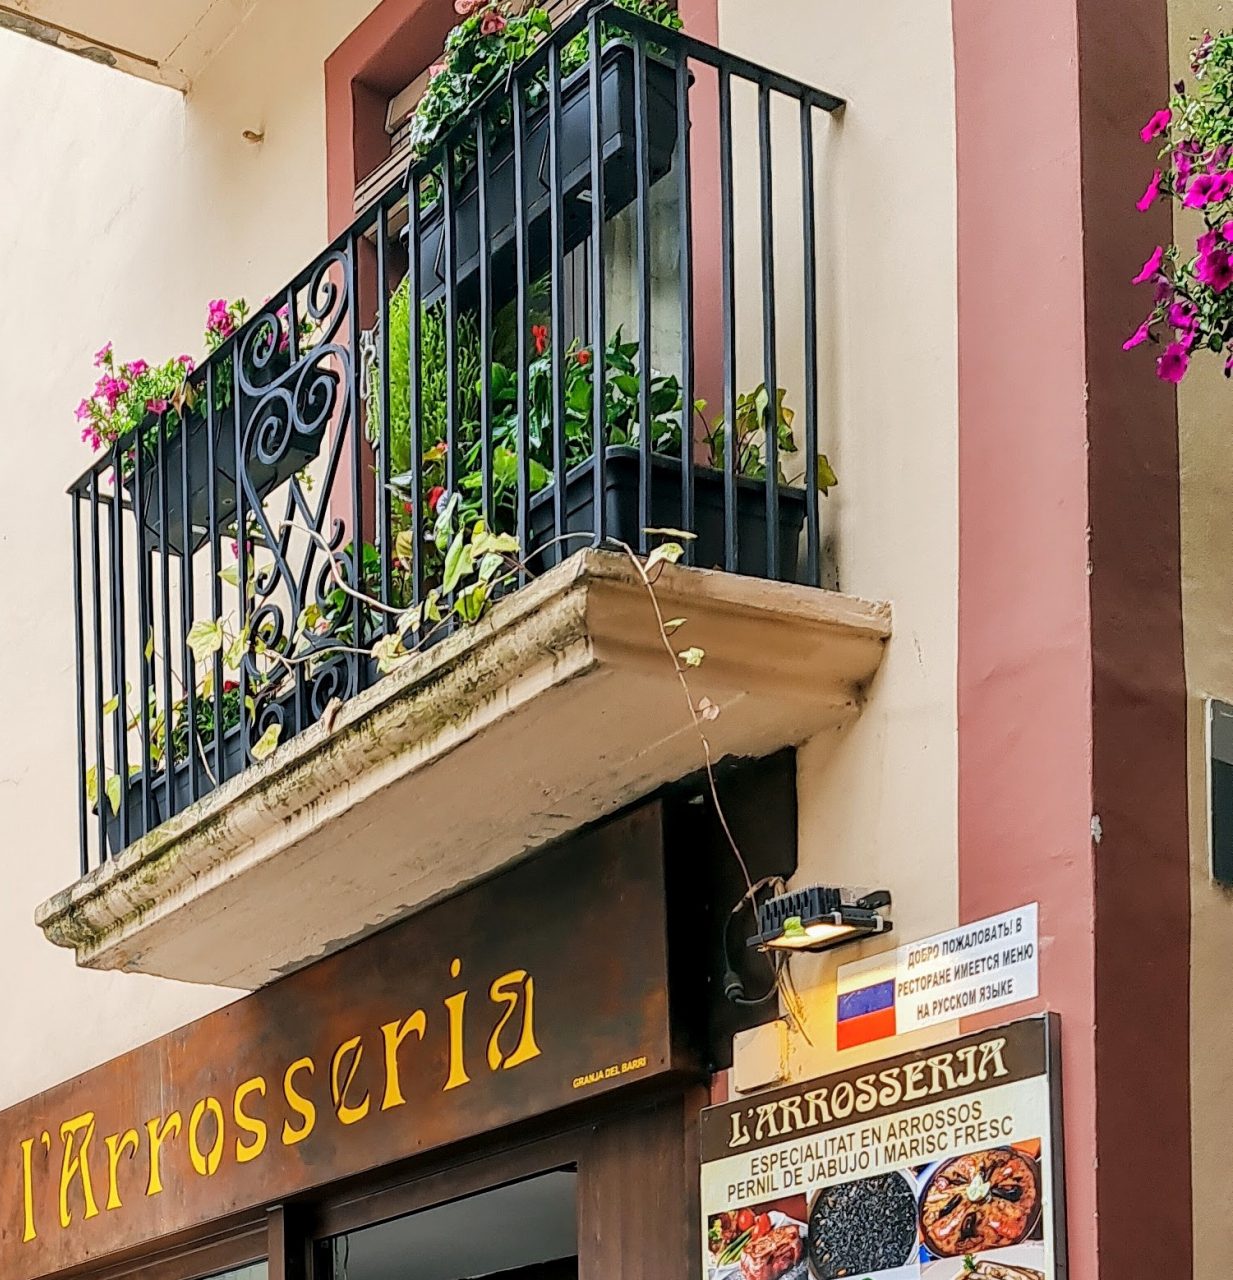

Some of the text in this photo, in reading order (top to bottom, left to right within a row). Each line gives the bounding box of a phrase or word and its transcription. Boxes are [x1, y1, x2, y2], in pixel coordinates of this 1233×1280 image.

[897, 943, 1034, 998] РЕСТОРАНЕ ИМЕЕТСЯ МЕНЮ
[908, 917, 1022, 970] ДОБРО ПОЖАЛОВАТЬ! В
[917, 979, 1013, 1020] НА РУССКОМ ЯЗЫКЕ
[572, 1056, 647, 1089] GRANJA DEL BARRI
[727, 1115, 1014, 1203] PERNIL DE JABUJO I MARISC FRESC
[751, 1100, 983, 1177] ESPECIALITAT EN ARROSSOS
